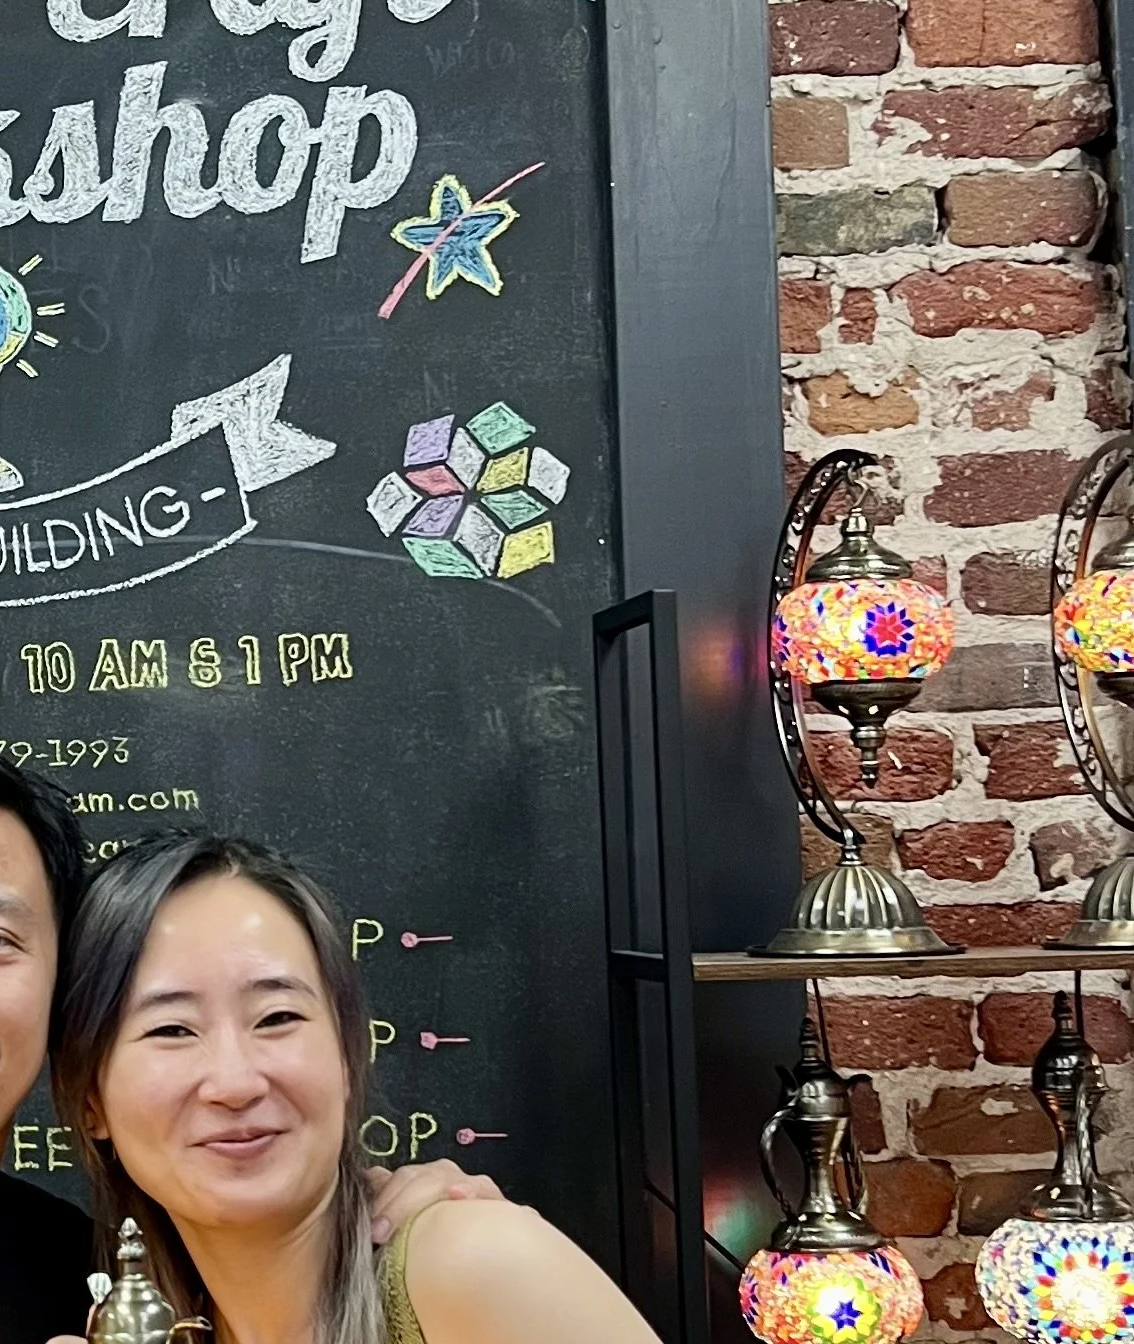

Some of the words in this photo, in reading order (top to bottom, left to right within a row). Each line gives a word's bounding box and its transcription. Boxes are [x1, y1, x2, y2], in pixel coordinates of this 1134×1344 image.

[20, 640, 76, 694] 10
[88, 637, 168, 692] AM
[237, 634, 262, 686] 1
[277, 631, 354, 688] PM
[66, 786, 201, 814] am.com
